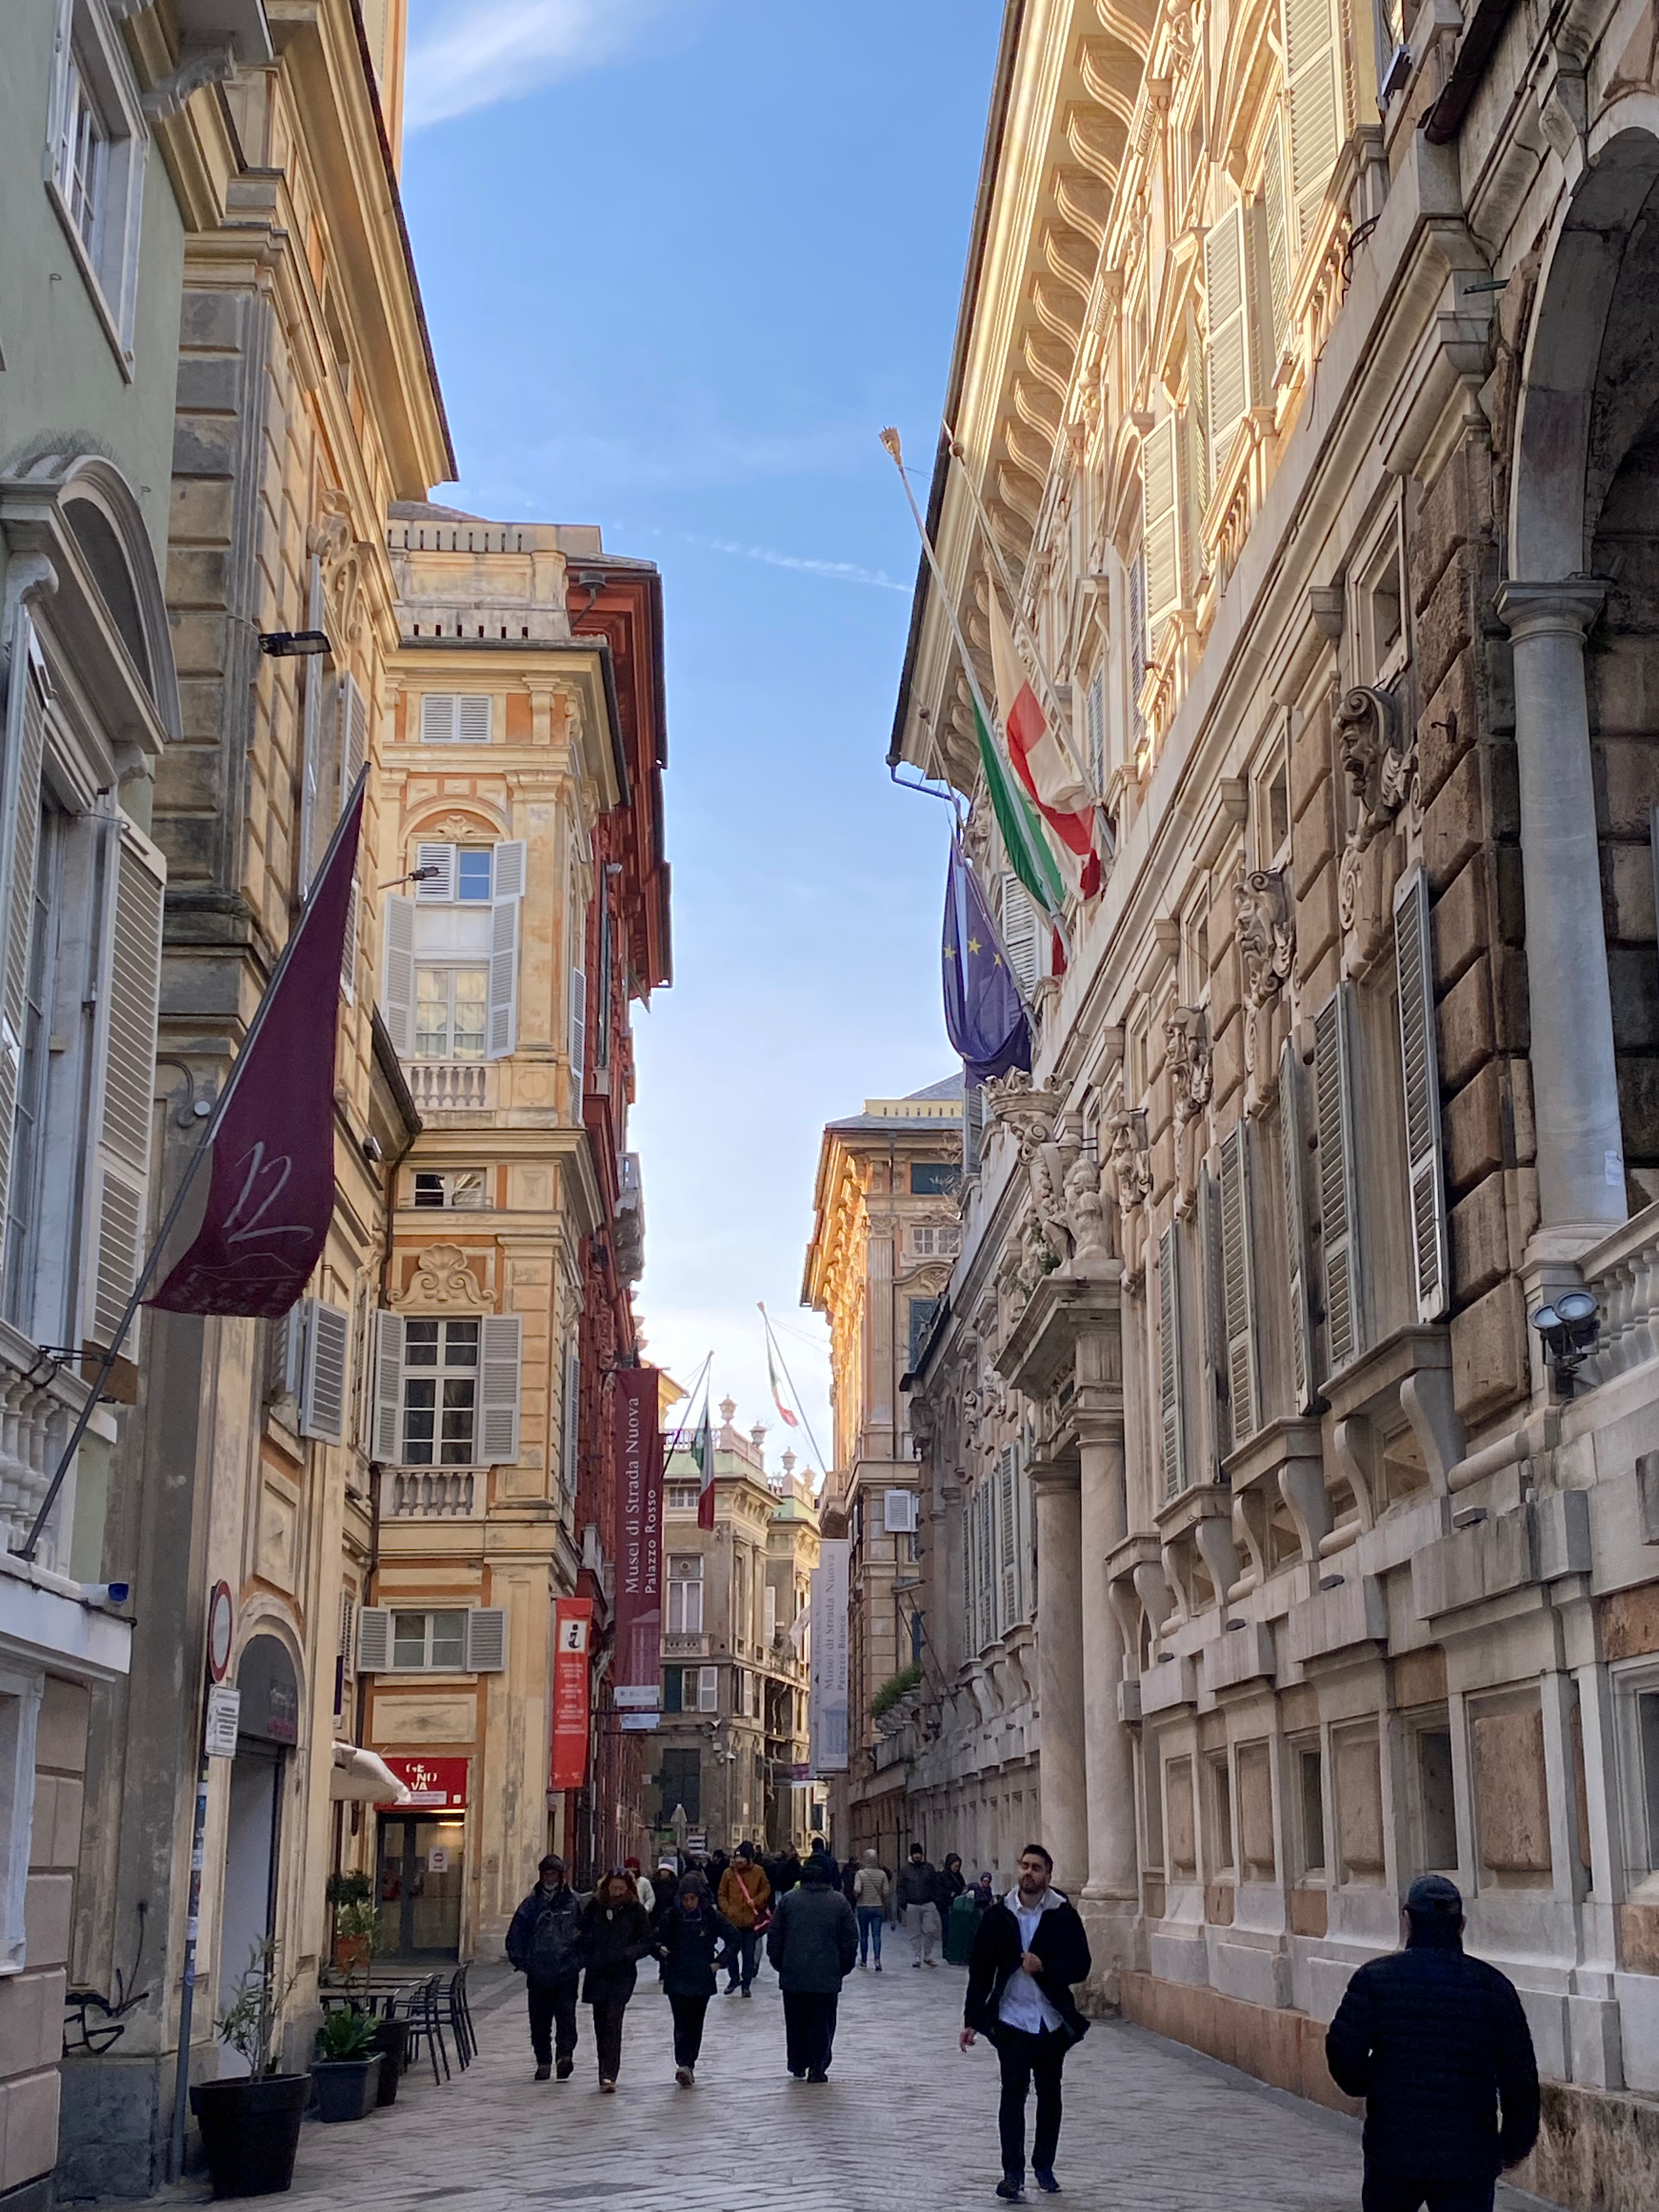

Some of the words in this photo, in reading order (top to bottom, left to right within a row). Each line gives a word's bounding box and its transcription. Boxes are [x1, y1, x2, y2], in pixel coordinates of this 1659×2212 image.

[625, 1397, 640, 1454] Nuova
[625, 1461, 640, 1514] Strada
[625, 1520, 640, 1536] di
[644, 1489, 657, 1533] Rosso
[625, 1542, 640, 1594] Musei
[644, 1539, 657, 1594] Palazzo
[825, 1554, 834, 1593] Nuova
[825, 1598, 834, 1635] Strada
[837, 1615, 846, 1649] Bianco
[824, 1639, 834, 1650] di
[837, 1653, 846, 1690] Palazzo
[411, 1782, 428, 1791] VA
